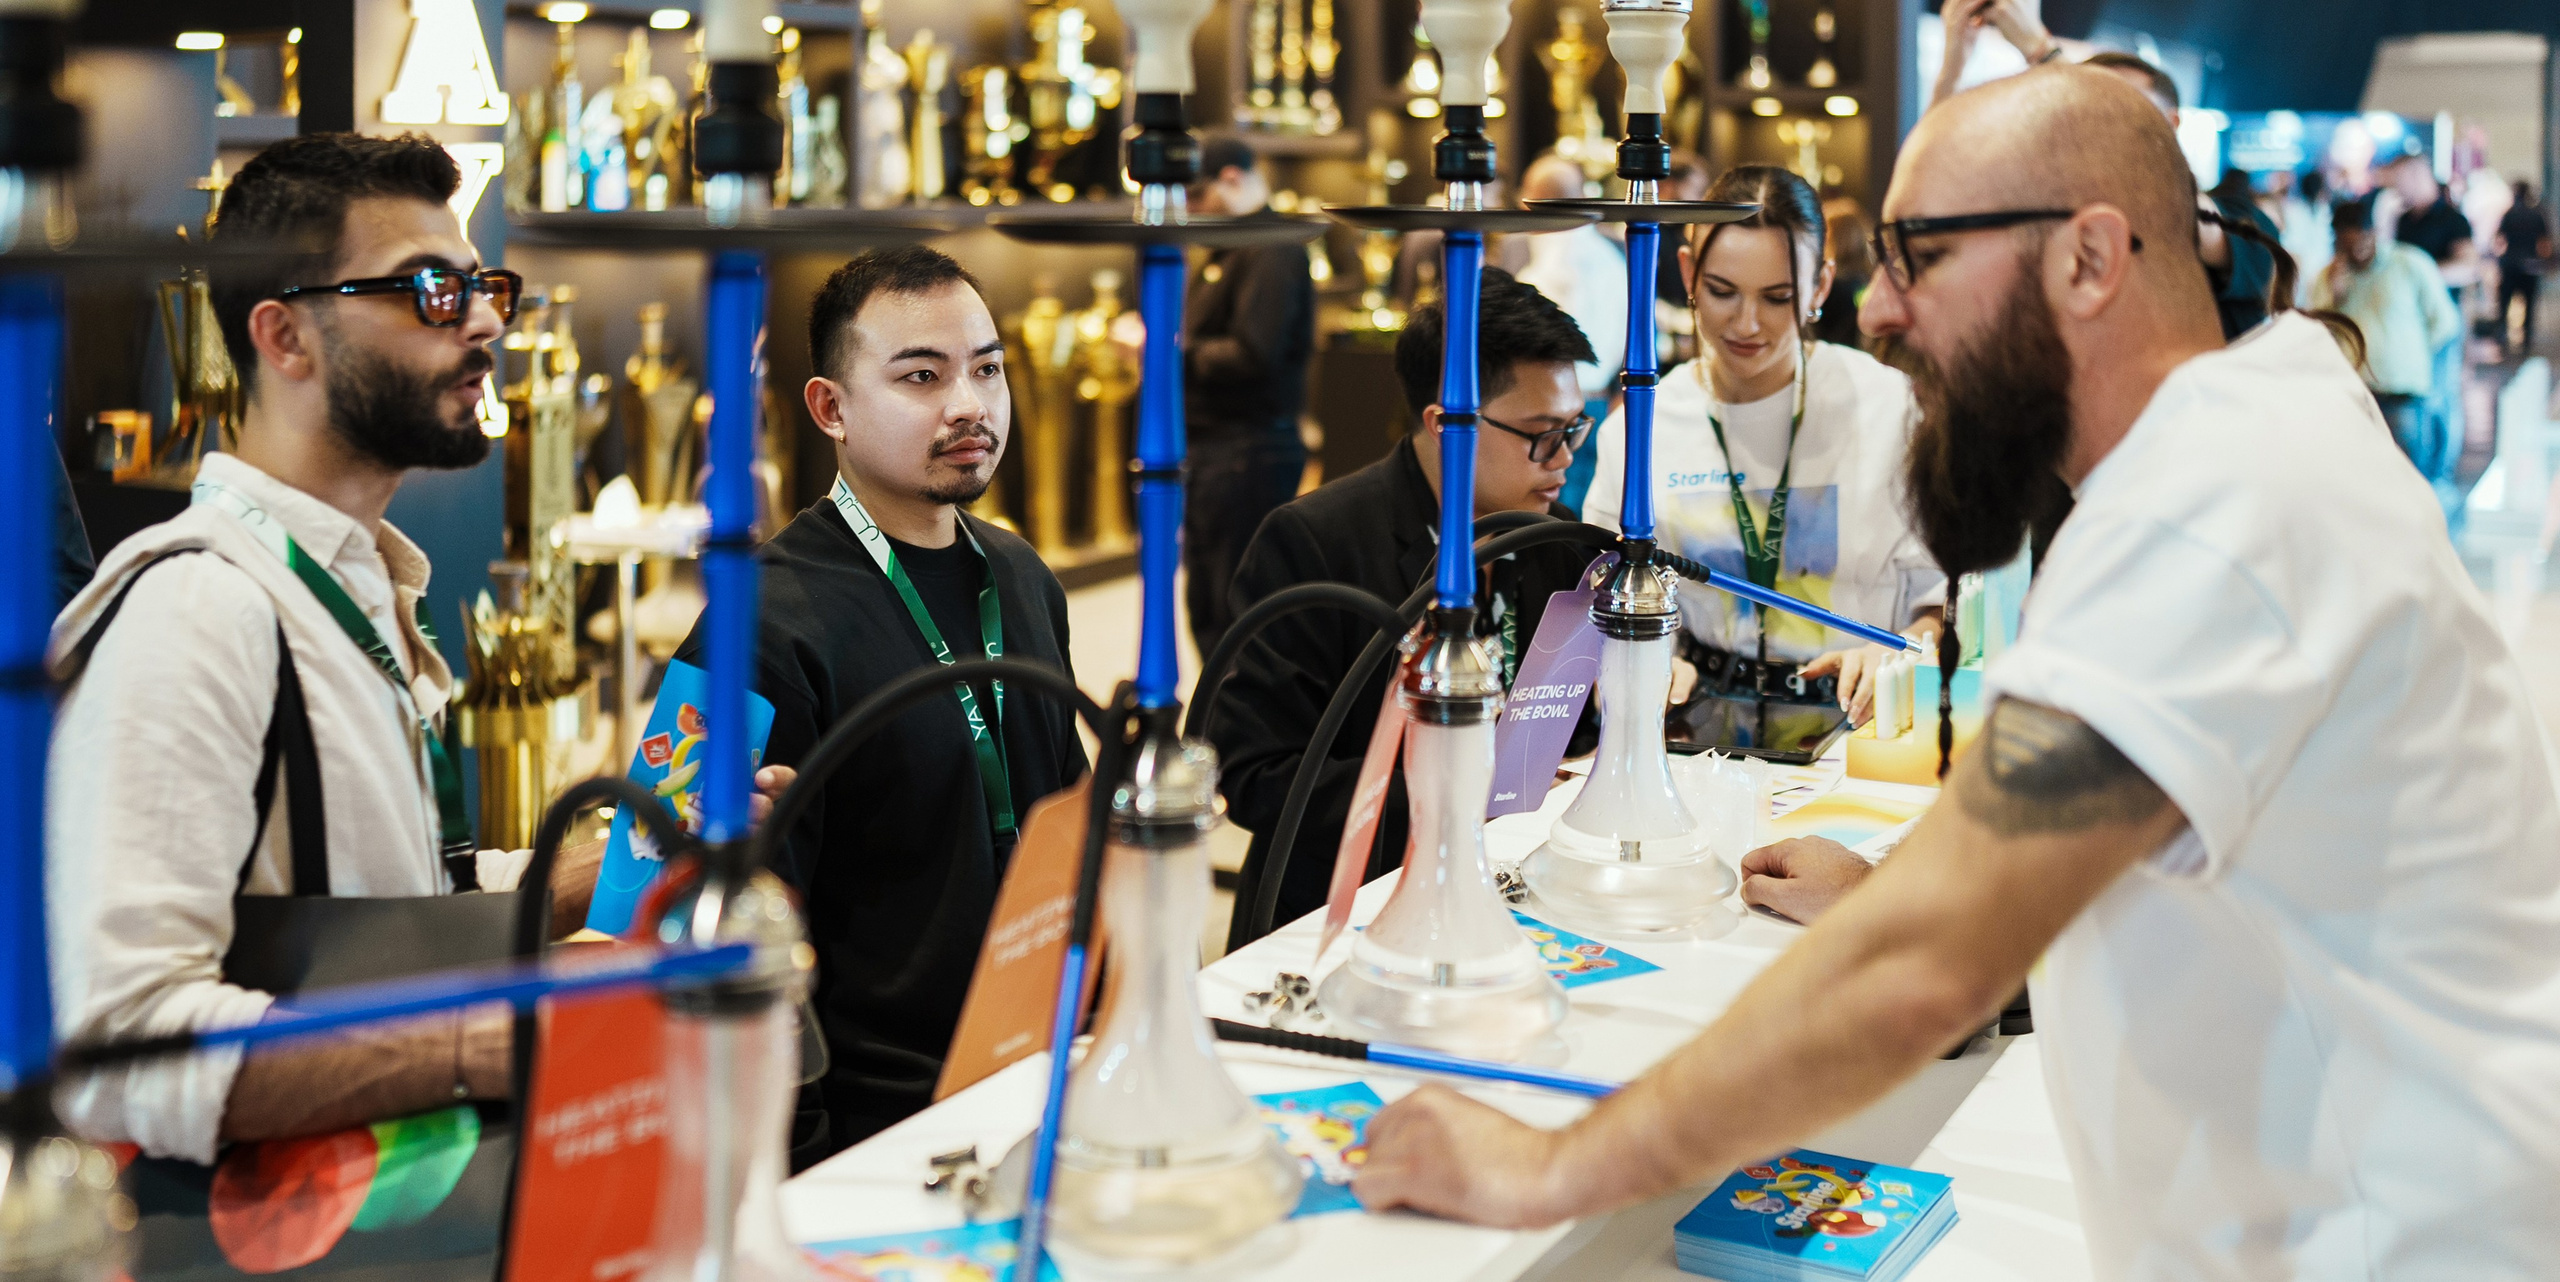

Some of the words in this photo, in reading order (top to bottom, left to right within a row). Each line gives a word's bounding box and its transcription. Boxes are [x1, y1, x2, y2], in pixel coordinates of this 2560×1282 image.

[1762, 537, 1779, 562] YA
[1502, 608, 1517, 659] LAYL
[937, 639, 974, 703] LYL
[1505, 662, 1516, 687] YA
[1510, 684, 1565, 703] HEATING
[1566, 683, 1587, 699] UP
[967, 704, 987, 742] YA
[1509, 706, 1532, 723] THE
[1531, 703, 1571, 720] BOWL
[1775, 1180, 1837, 1230] Starline
